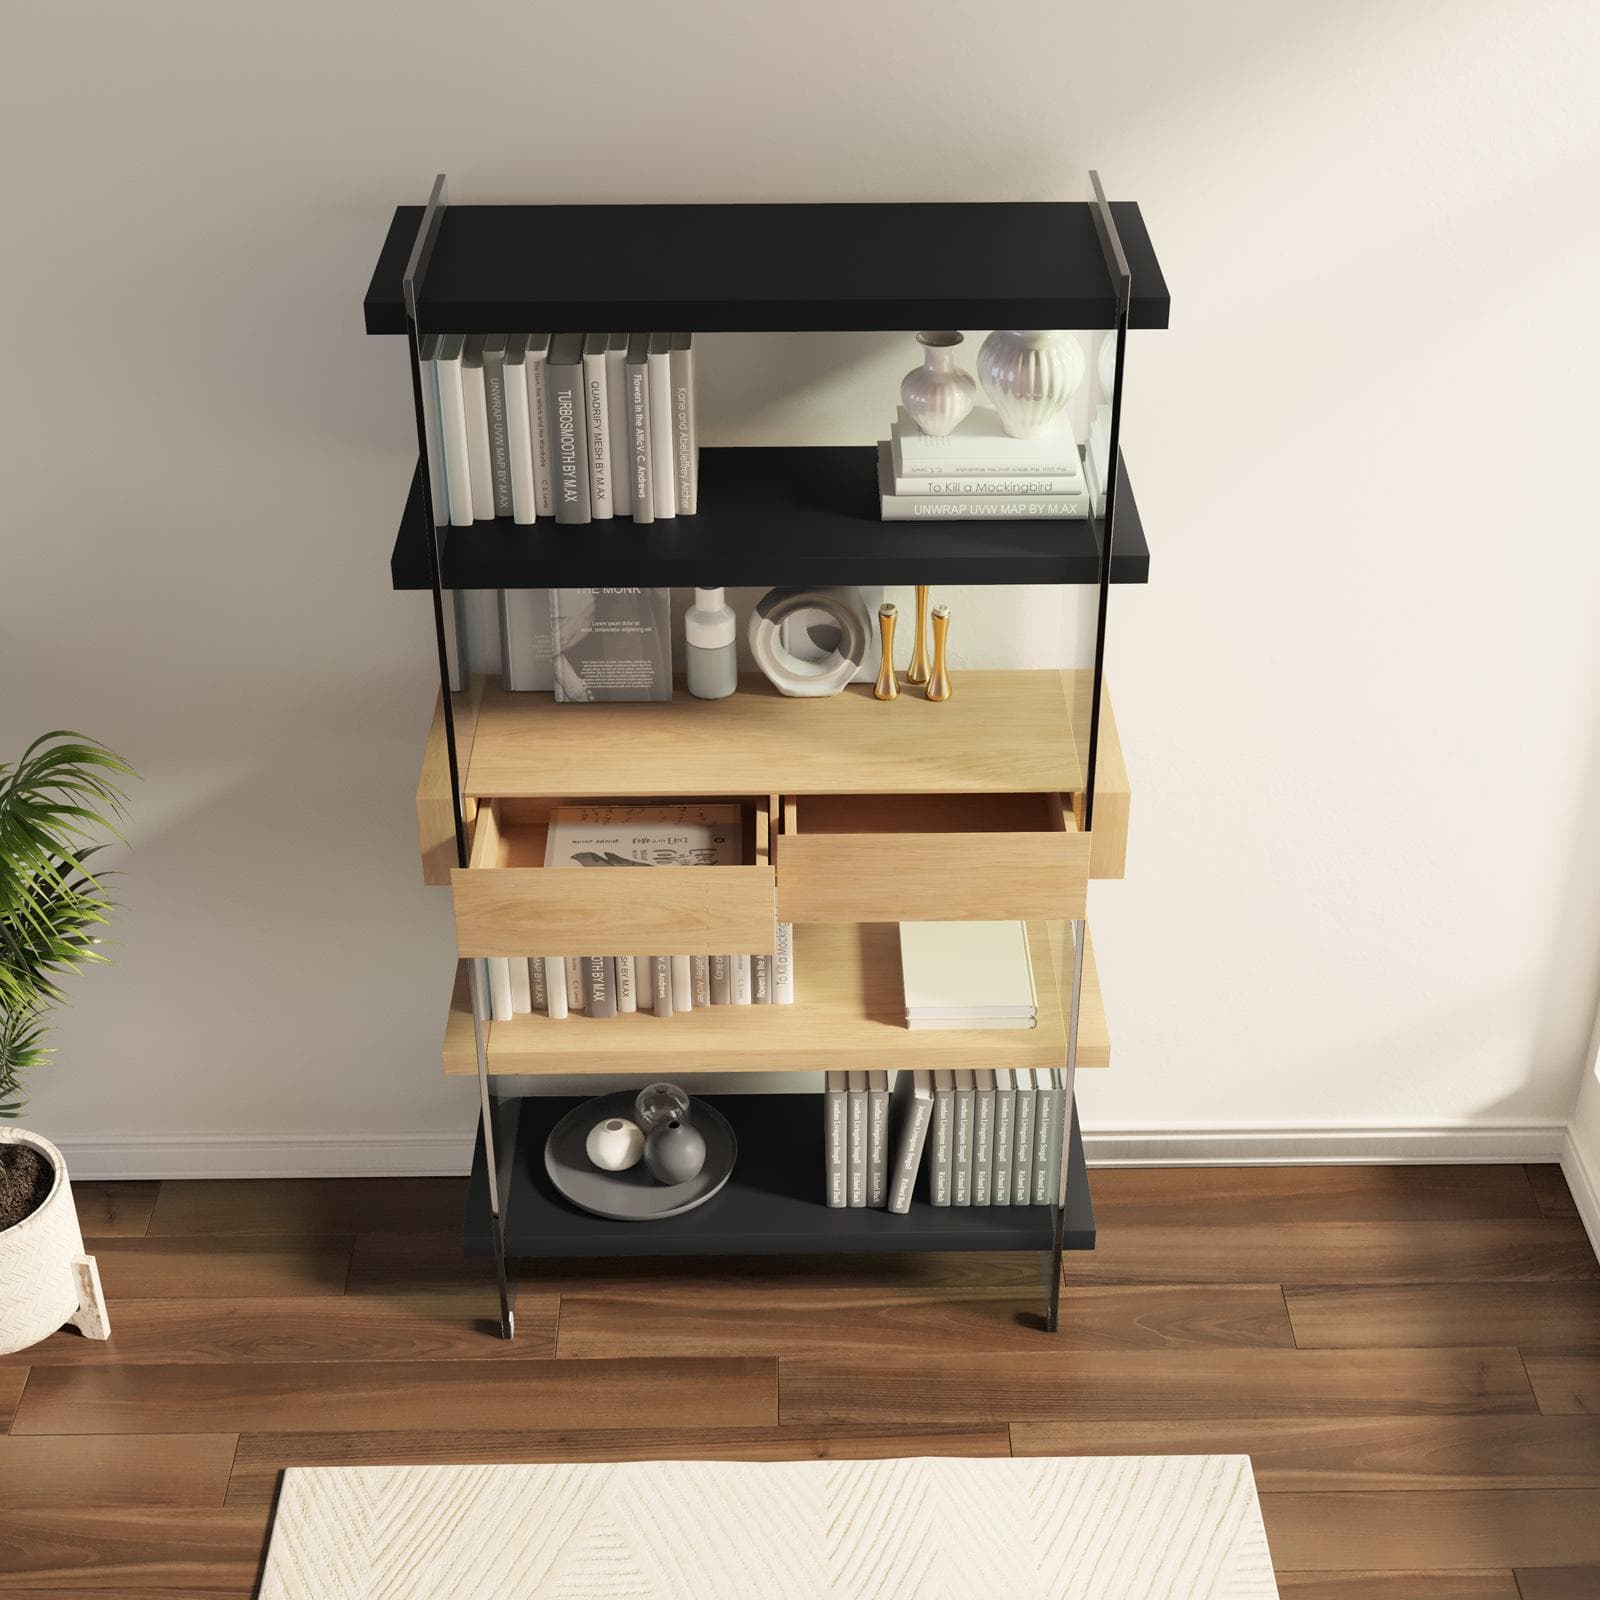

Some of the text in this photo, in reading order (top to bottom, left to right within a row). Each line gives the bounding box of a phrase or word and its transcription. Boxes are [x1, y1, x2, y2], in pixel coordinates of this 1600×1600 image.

[633, 374, 642, 403] Flowers
[490, 377, 502, 420] UNWRAP
[678, 387, 687, 411] Kane
[635, 405, 643, 413] in
[635, 414, 644, 427] the
[678, 412, 688, 430] and
[494, 424, 505, 446] UVW
[591, 381, 606, 500] QUADRIFY MESH BY M.AX
[558, 390, 577, 503] TURBOSMOOTH BY M.AX
[496, 448, 506, 468] MAP
[498, 470, 507, 483] BY
[638, 466, 647, 498] Andrews
[680, 480, 689, 508] Archer
[928, 481, 1053, 494] To Kill a Mockingbird
[914, 503, 1077, 515] UNWRAP UVW MAP BY M.AX
[776, 921, 790, 956] Mocking
[621, 956, 629, 966] SH
[757, 960, 766, 969] the
[776, 965, 788, 975] Kill
[592, 972, 604, 983] BY
[621, 969, 629, 977] BY
[777, 977, 788, 985] To
[592, 983, 605, 1002] M.AX
[658, 972, 666, 998] Andrews
[696, 980, 705, 1003] Archer
[756, 976, 766, 998] Flowers
